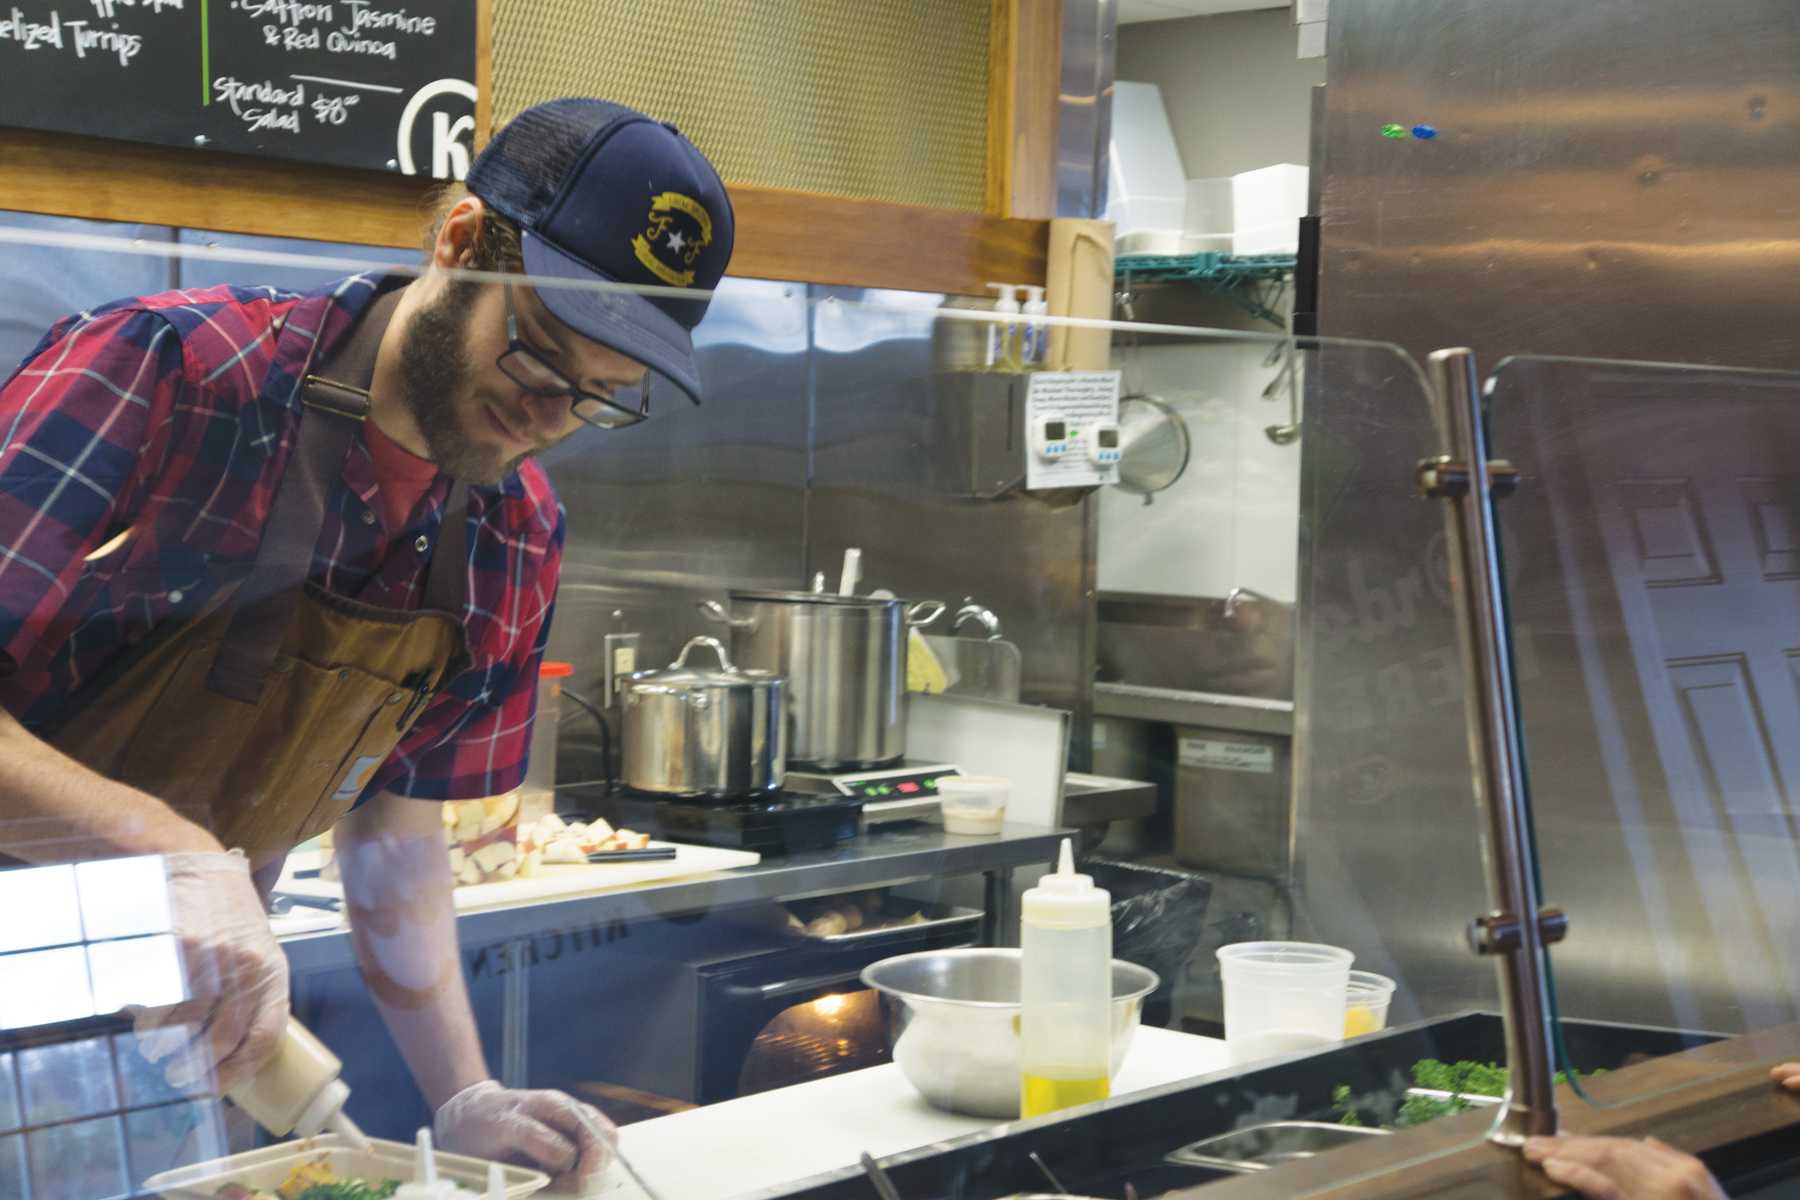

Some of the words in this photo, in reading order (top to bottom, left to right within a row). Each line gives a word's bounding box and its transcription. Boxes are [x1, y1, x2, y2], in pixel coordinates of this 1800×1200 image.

[340, 0, 436, 36] Jasmine
[63, 20, 143, 67] Turnips
[326, 31, 396, 60] Quinoa
[212, 77, 304, 116] Standard
[242, 108, 300, 133] Salad
